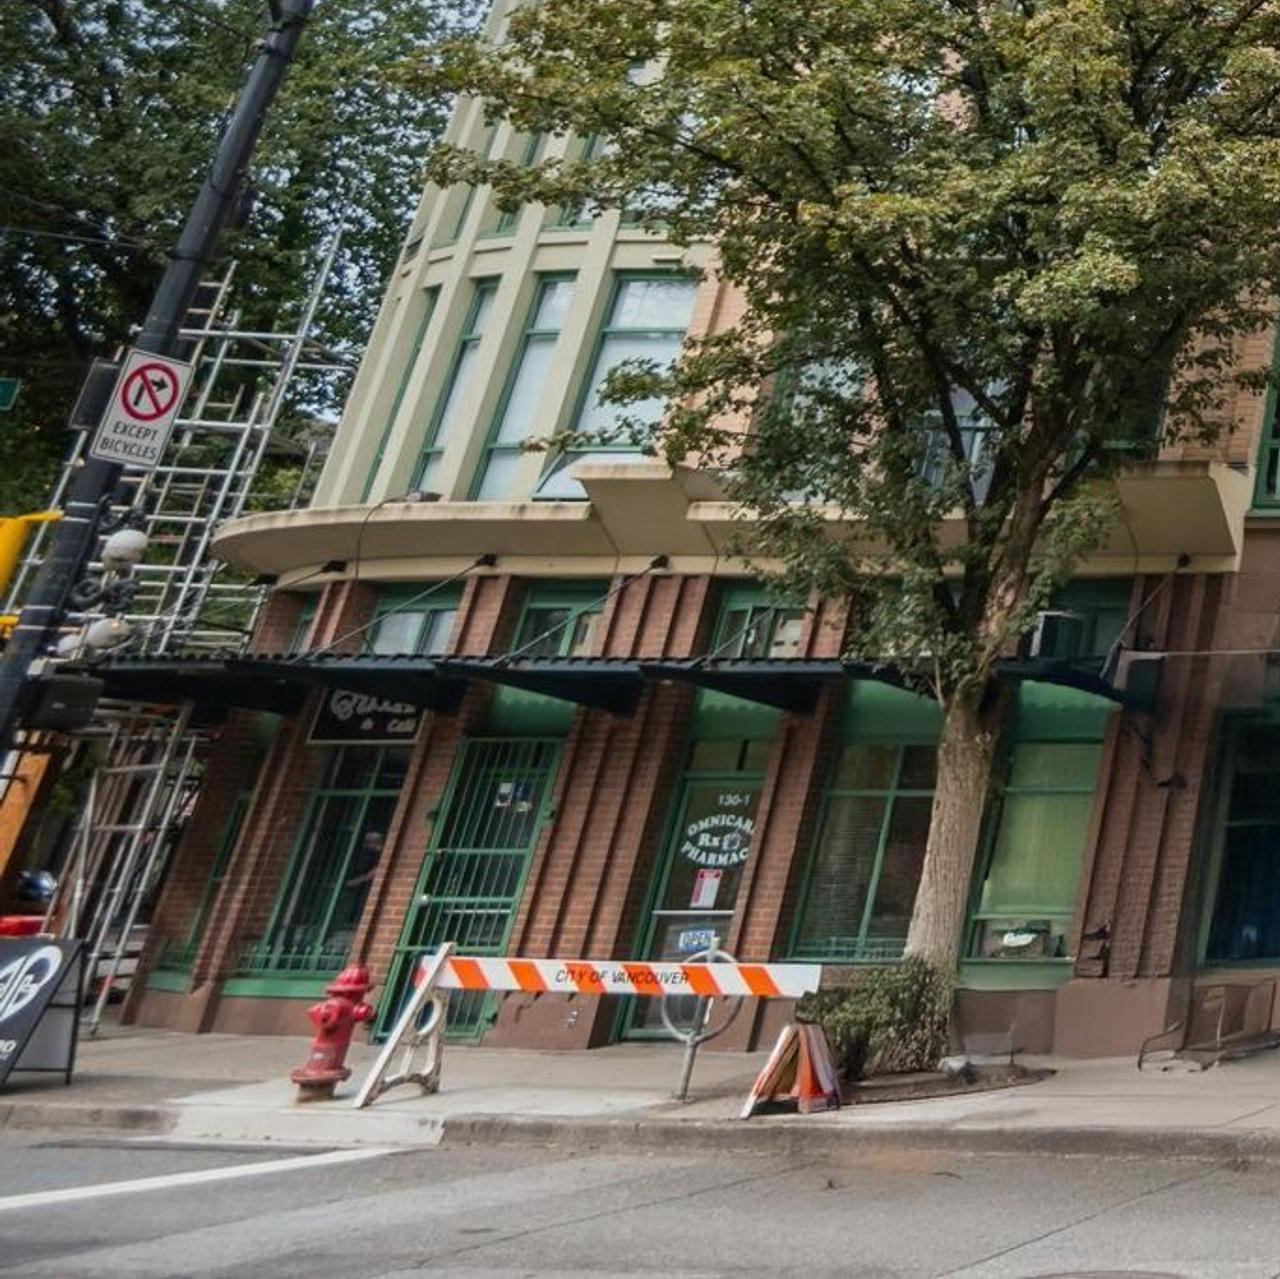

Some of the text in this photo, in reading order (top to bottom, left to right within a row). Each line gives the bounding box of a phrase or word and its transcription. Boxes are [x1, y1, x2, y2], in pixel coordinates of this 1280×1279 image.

[113, 422, 157, 439] EXCEPT
[101, 438, 157, 459] BICYCLES
[719, 794, 751, 806] 130-1
[687, 814, 755, 837] OMNICAR
[681, 841, 749, 866] PHARMAC
[555, 970, 689, 985] CITY OF VANCOUVER
